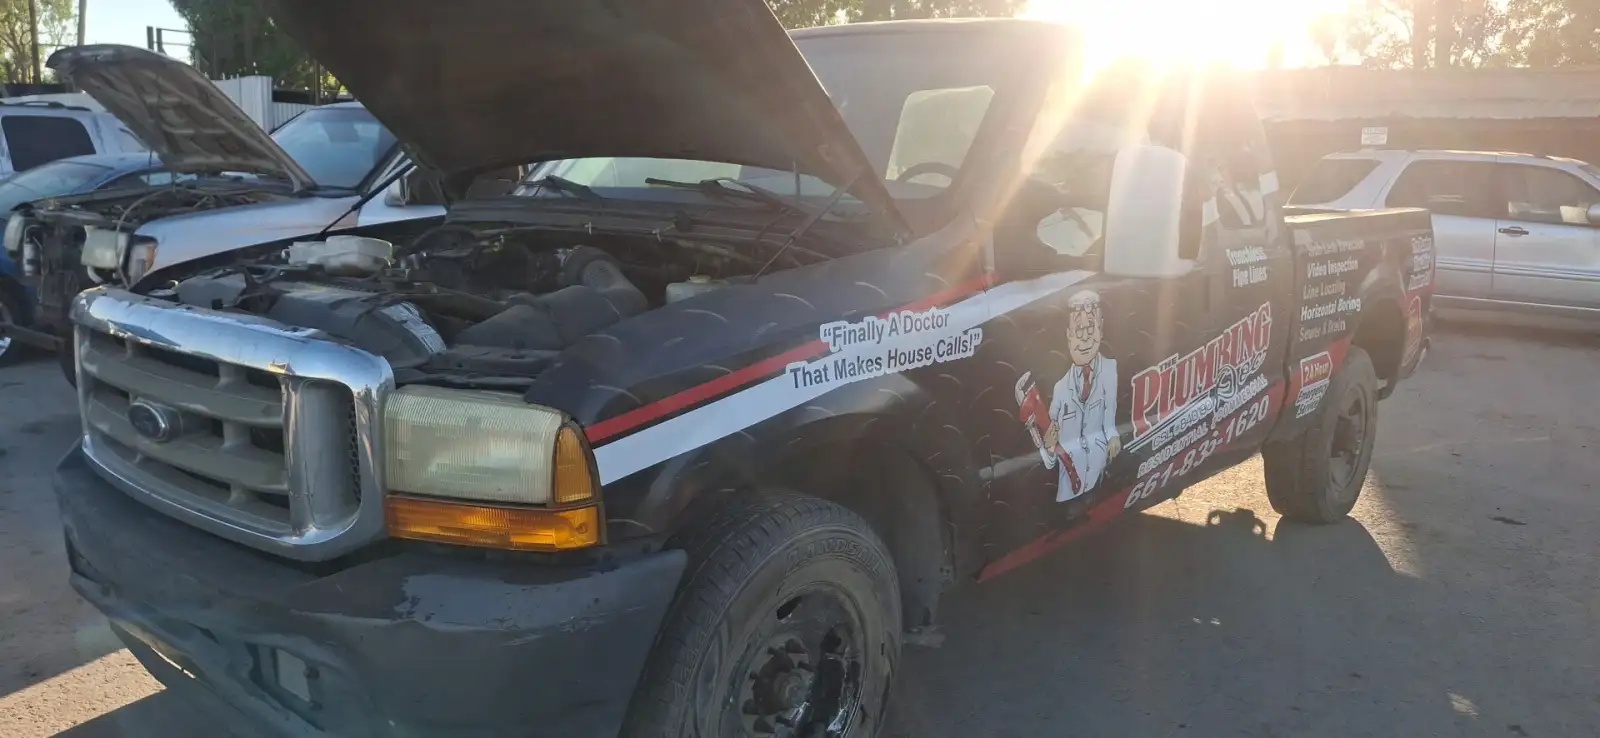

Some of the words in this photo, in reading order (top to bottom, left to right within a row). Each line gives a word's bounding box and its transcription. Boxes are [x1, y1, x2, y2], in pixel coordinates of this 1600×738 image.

[1233, 268, 1248, 288] Pipe
[1249, 265, 1267, 283] Lines
[1307, 262, 1327, 278] Video
[1328, 255, 1359, 276] Inspection
[1302, 282, 1319, 300] Line
[1301, 298, 1337, 321] Horizontal
[1337, 296, 1362, 312] Boring
[888, 316, 900, 337] A
[903, 311, 950, 334] Doctor
[1299, 325, 1321, 342] Sewer
[790, 364, 830, 389] That
[834, 355, 883, 381] Makes
[887, 344, 932, 369] House
[1131, 301, 1272, 439] PLUMBING
[1159, 356, 1177, 371] THE
[1304, 364, 1314, 383] 24
[1314, 361, 1329, 377] Hour
[1137, 421, 1209, 479] RESIDENTIAL
[1215, 374, 1269, 422] COMMERCIAL
